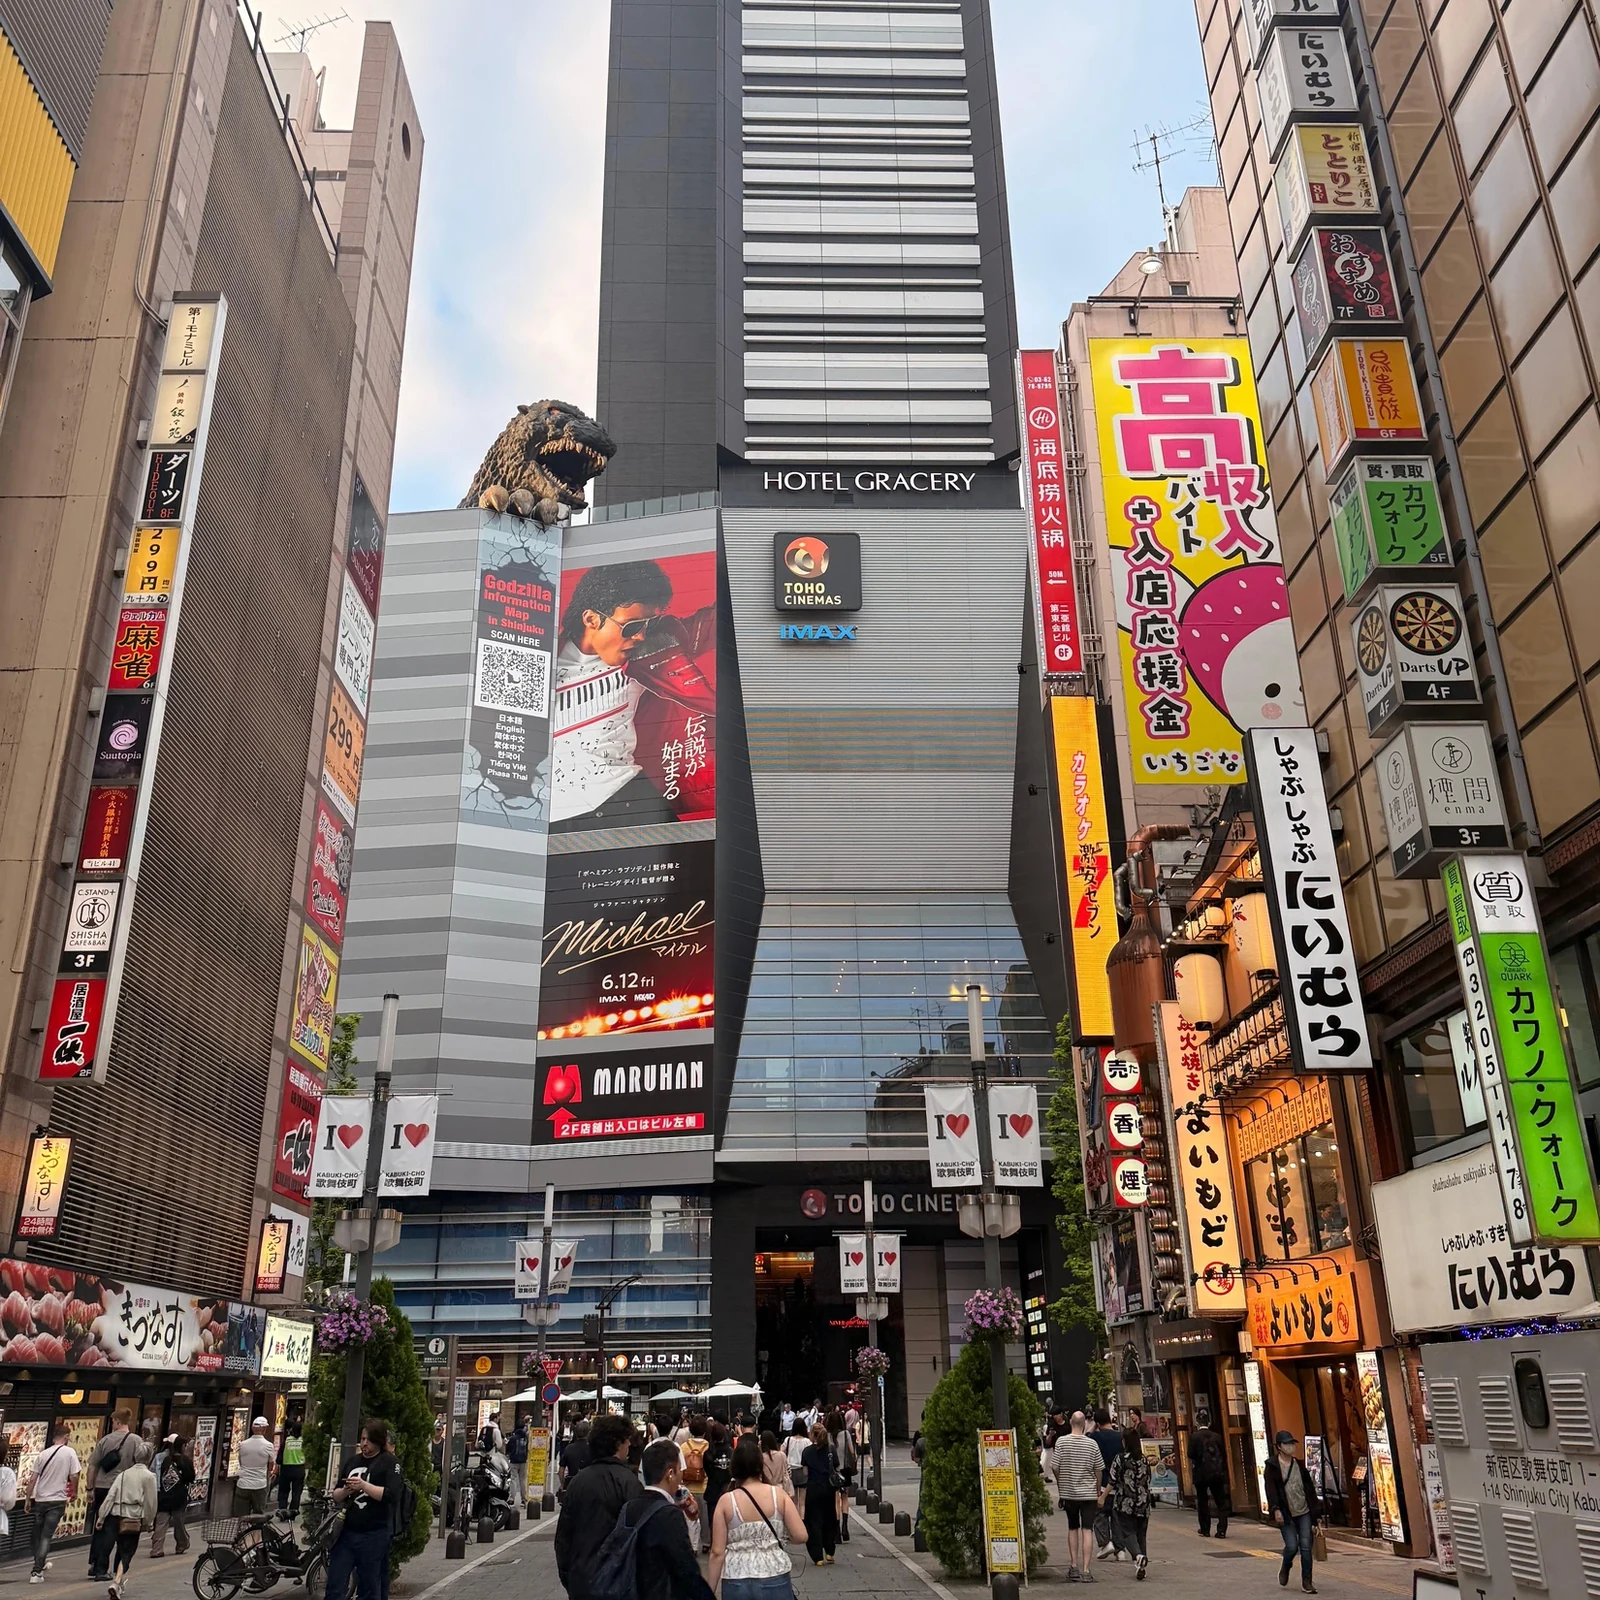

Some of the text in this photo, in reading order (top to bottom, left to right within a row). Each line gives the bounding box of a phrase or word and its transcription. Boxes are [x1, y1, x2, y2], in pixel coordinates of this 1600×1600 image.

[1298, 32, 1335, 108] にいむら
[1330, 232, 1381, 304] おすすめ
[1336, 306, 1355, 318] 7F
[1356, 349, 1375, 418] TORIKIZOKU
[1379, 428, 1397, 438] 6F
[1116, 347, 1265, 554] 高収入
[1367, 464, 1425, 478] 質・買取
[146, 453, 163, 519] HIDEOUT
[161, 453, 188, 506] ダーツ
[763, 471, 977, 492] HOTEL GRACERY
[159, 508, 175, 519] 8F
[1168, 476, 1203, 555] バイト
[138, 528, 163, 591] 299円
[1429, 552, 1447, 563] 5F
[484, 574, 552, 602] Godzilla
[784, 582, 825, 594] TOHO
[125, 594, 155, 603] 九十九
[784, 595, 842, 605] CINEMAS
[504, 605, 530, 622] Map
[1049, 603, 1069, 613] 第二
[121, 611, 166, 622] ウェルカム
[500, 618, 545, 635] Shinjuku
[779, 624, 857, 640] IMAX
[1051, 623, 1071, 632] 会館
[490, 629, 541, 647] SCAN HERE
[1053, 633, 1071, 642] ビル
[114, 624, 160, 680] 麻雀
[1058, 648, 1069, 658] 6F
[1400, 661, 1438, 674] Darts
[1426, 683, 1451, 699] 4F
[141, 697, 152, 705] 5F
[1378, 698, 1390, 718] 4F
[498, 713, 523, 726] 日本語
[495, 722, 526, 735] English
[684, 714, 706, 777] 伝説が
[99, 751, 142, 762] Suutopia
[497, 750, 521, 762] 한국어
[1144, 750, 1240, 773] いちごな
[487, 768, 529, 781] Phasa Thai
[661, 739, 683, 801] 始まる
[1070, 750, 1093, 841] カラオケ
[1272, 735, 1318, 865] しゃぶしゃぶ
[1444, 804, 1485, 815] enma
[1458, 828, 1481, 845] 3F
[1405, 842, 1416, 861] 3F
[77, 888, 117, 897] C.STAND+
[1074, 842, 1102, 940] 激安セブン
[1483, 904, 1526, 919] 買取
[70, 931, 108, 940] SHISHA
[541, 900, 716, 968] Michael
[69, 939, 107, 947] CAFE&BAR
[651, 942, 708, 958] マイケル
[74, 954, 95, 968] 3F
[1284, 869, 1362, 1058] にいむら
[601, 973, 655, 990] 6.12 fri
[1500, 973, 1533, 982] QUARK
[68, 983, 89, 1022] 居酒屋
[599, 994, 627, 1004] IMAX
[79, 1069, 93, 1077] 2F
[593, 1061, 704, 1096] MARUHAN
[1505, 986, 1579, 1228] カワノ・クォーク
[560, 1115, 697, 1137] 2F店舗出入口はビル左側
[934, 1114, 947, 1140] I
[997, 1114, 1010, 1140] I
[1113, 1113, 1134, 1134] 香
[323, 1124, 337, 1151] I
[391, 1123, 403, 1150] I
[36, 1139, 60, 1212] きづなすし
[385, 1170, 426, 1178] KABUKI-CHO
[936, 1167, 976, 1178] 歌舞伎町
[999, 1167, 1038, 1178] 歌舞伎町
[1119, 1170, 1140, 1190] 煙
[1431, 1163, 1487, 1193] shabushabu sukiyaki
[315, 1178, 358, 1189] 歌舞伎町
[383, 1178, 424, 1188] 歌舞伎町
[23, 1217, 55, 1226] 24時間
[20, 1226, 55, 1235] 年中無休
[1441, 1223, 1509, 1254] しゃぶしゃぶ・すき
[519, 1257, 526, 1273] I
[553, 1256, 561, 1272] I
[844, 1251, 851, 1267] I
[877, 1251, 884, 1267] I
[1447, 1248, 1576, 1311] にいむら
[1270, 1286, 1333, 1344] よいもど
[117, 1290, 190, 1366] きづなすし
[631, 1353, 694, 1363] ACORN
[1485, 1453, 1574, 1486] 新宿区歌舞伎町
[1482, 1481, 1570, 1513] 1-14 Shinjuku City
